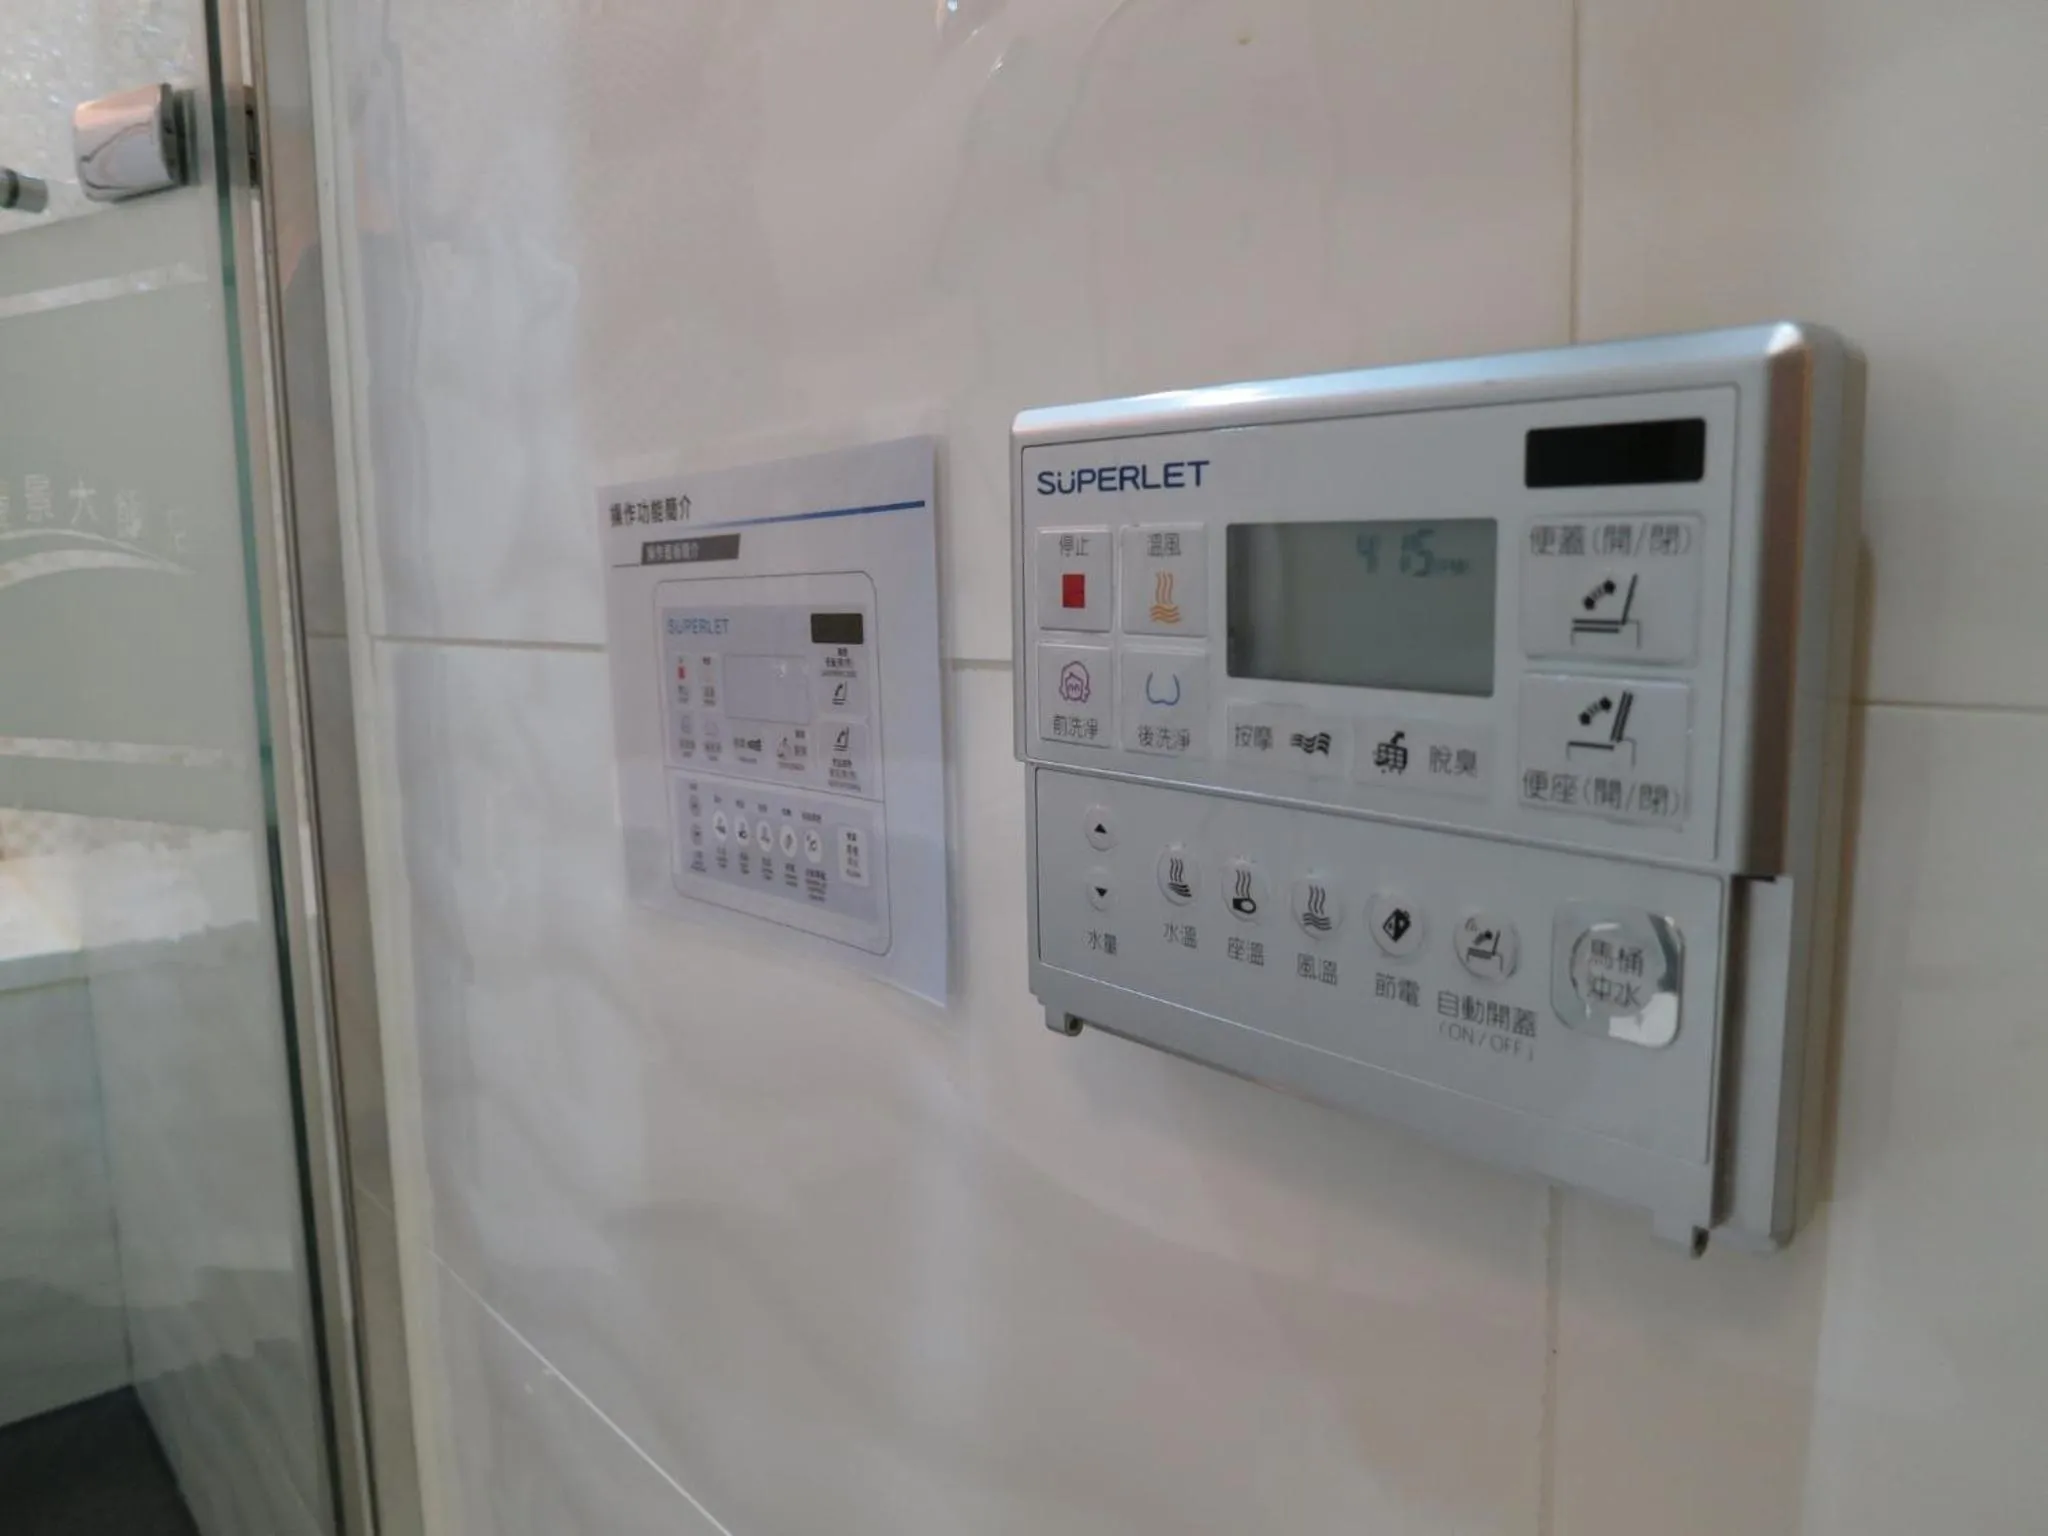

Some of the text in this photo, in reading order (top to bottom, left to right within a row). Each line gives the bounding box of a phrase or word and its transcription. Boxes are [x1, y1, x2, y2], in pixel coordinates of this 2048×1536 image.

[609, 494, 693, 528] 操作功能簡介
[1058, 535, 1091, 557] 停止
[1052, 714, 1098, 740] 前洗淨
[1137, 723, 1191, 752] 後洗淨
[1235, 724, 1274, 752] 按摩
[1086, 927, 1117, 957] 水量
[1589, 938, 1644, 978] 馬桶
[1374, 972, 1421, 1008] 節電
[1437, 990, 1537, 1038] 自動開蓋
